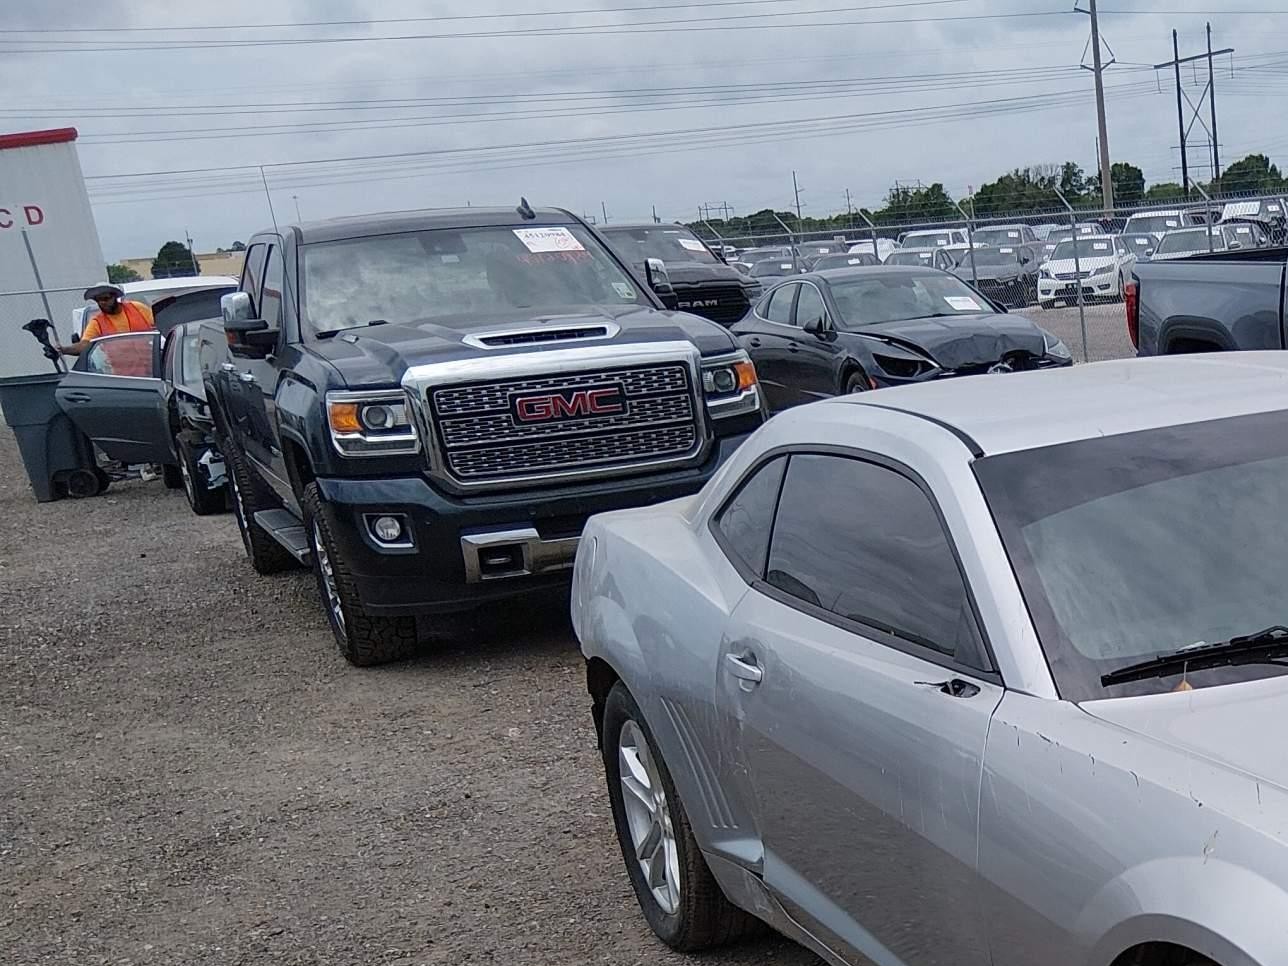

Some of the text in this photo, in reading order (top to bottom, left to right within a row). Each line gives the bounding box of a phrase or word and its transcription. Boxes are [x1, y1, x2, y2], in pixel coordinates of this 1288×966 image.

[24, 206, 44, 225] D
[678, 299, 718, 308] RAM
[516, 387, 623, 421] GMC
